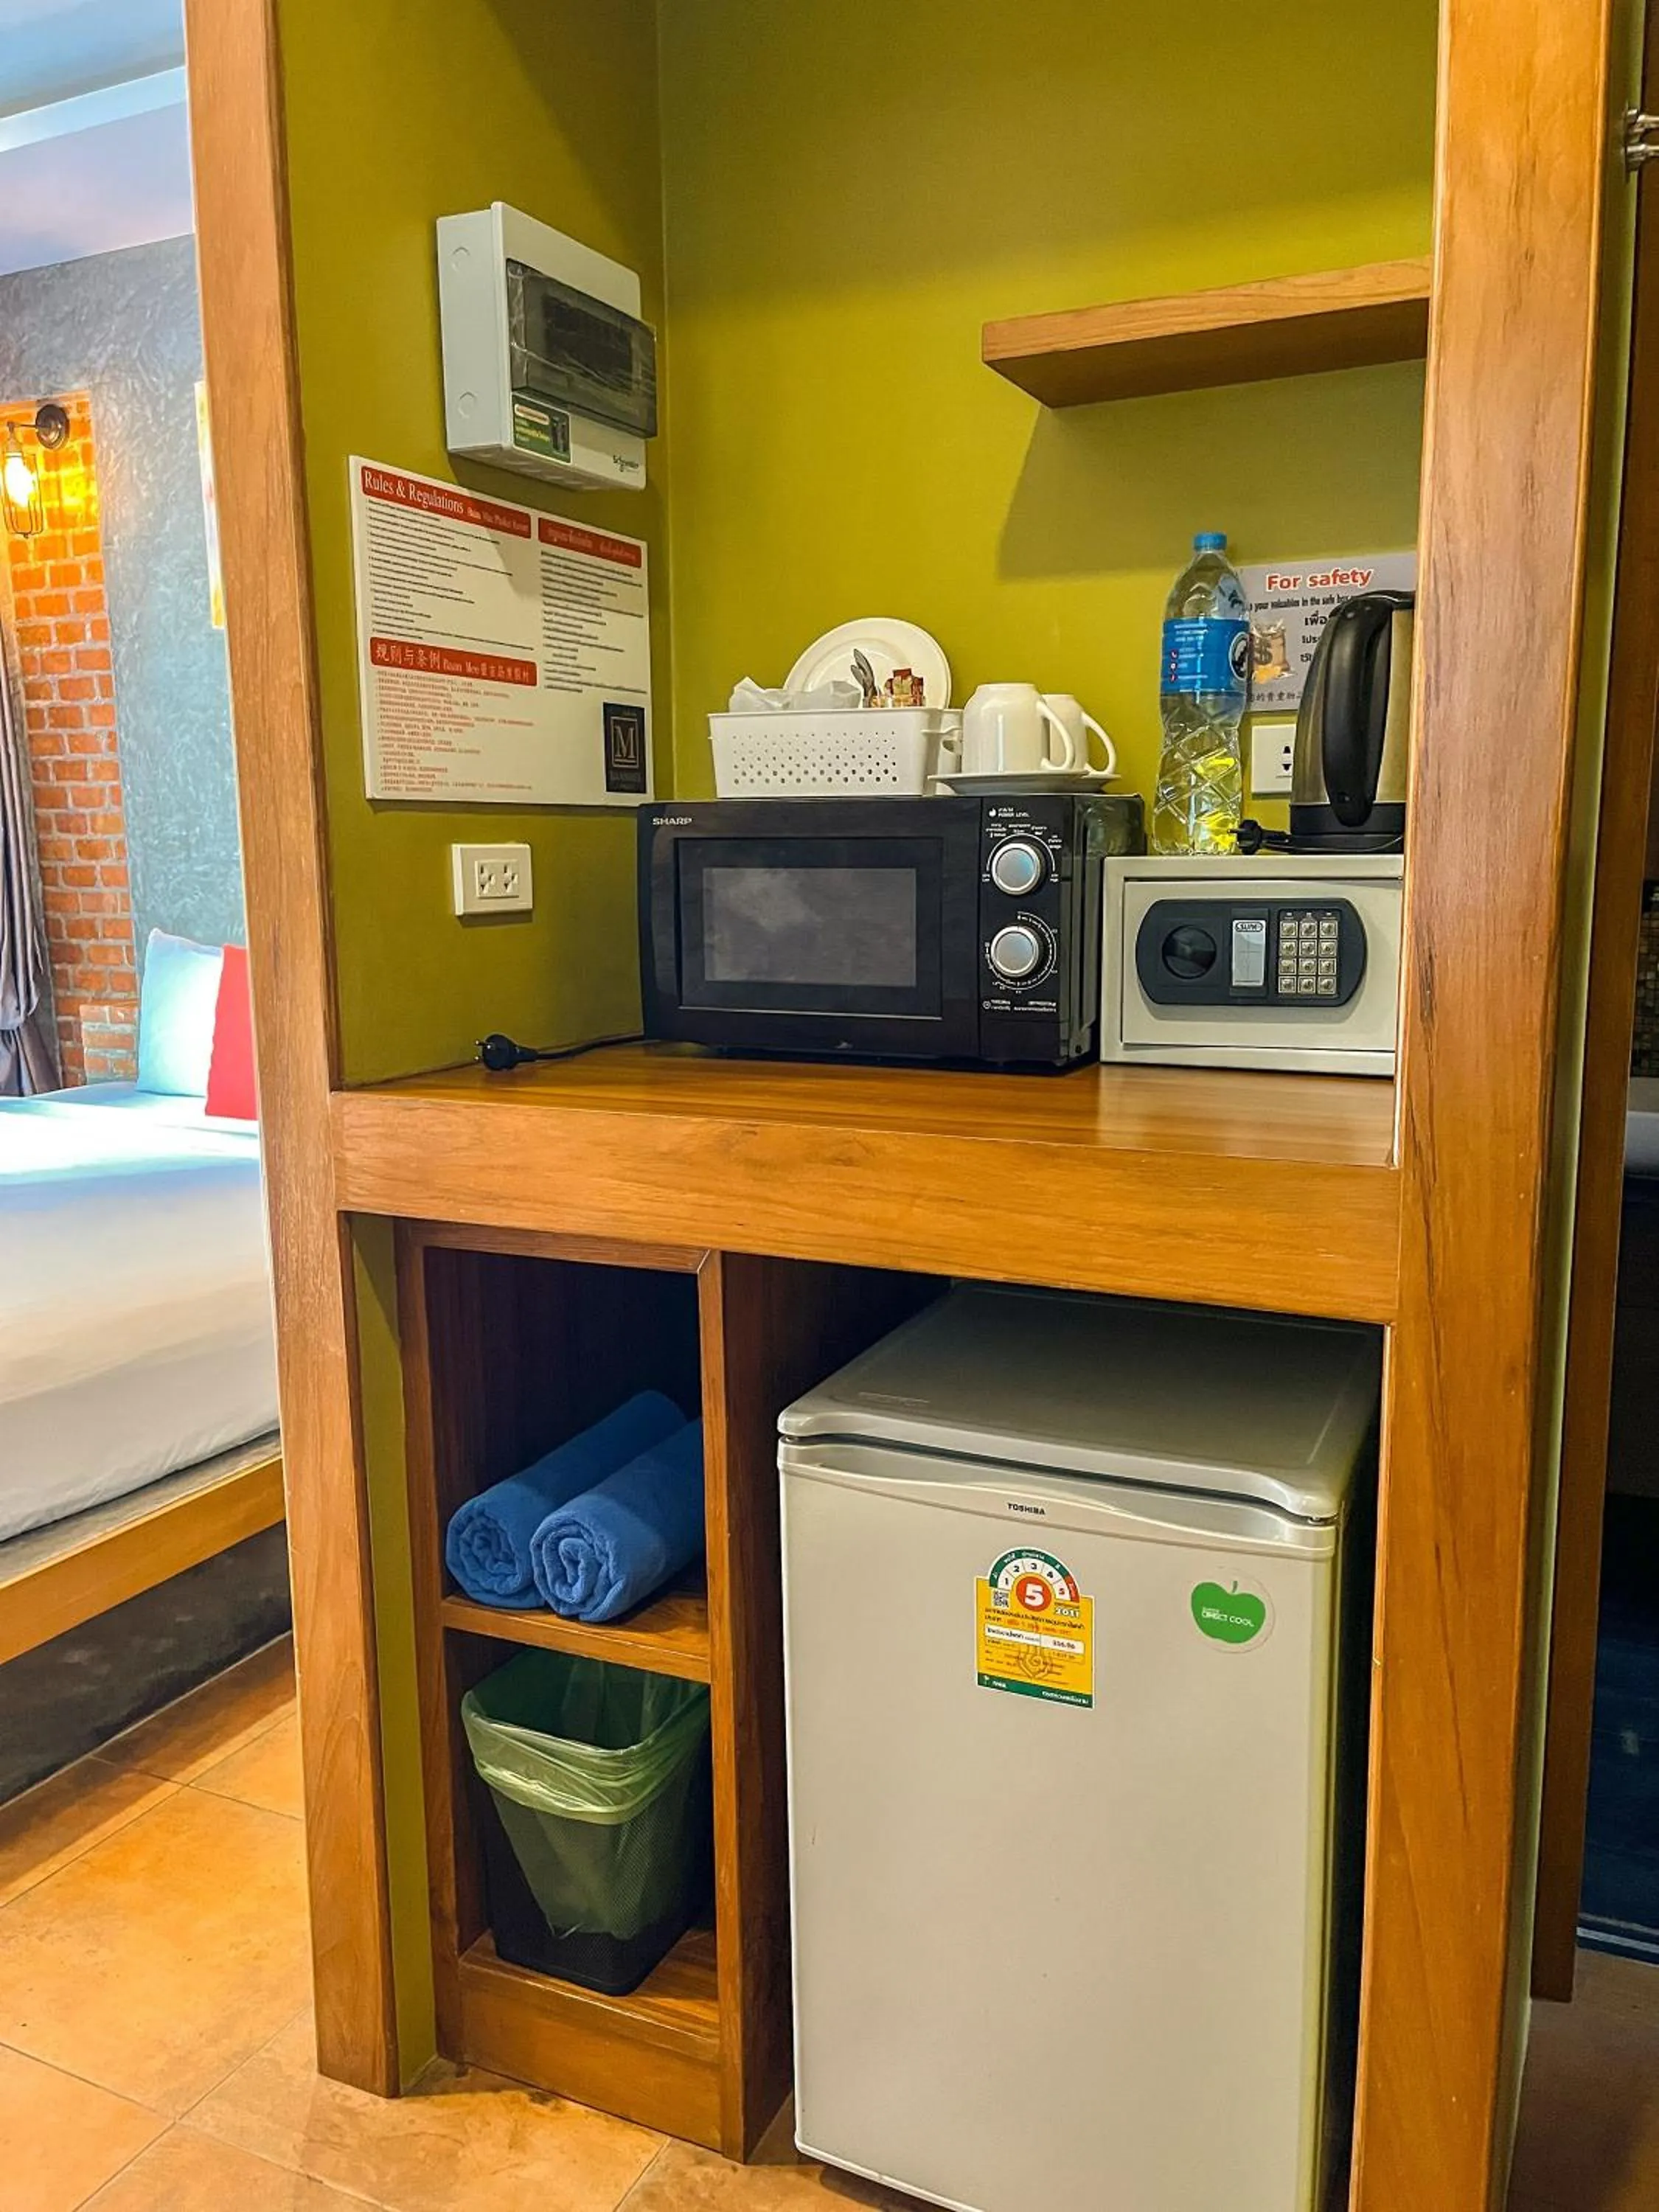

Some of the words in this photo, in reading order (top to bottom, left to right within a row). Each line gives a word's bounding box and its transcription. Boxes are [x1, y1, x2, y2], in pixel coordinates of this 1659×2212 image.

[364, 470, 394, 495] Rules
[396, 481, 406, 498] &
[408, 483, 464, 513] Regulations
[1267, 574, 1301, 591] For
[1308, 568, 1373, 588] safety
[613, 725, 636, 759] M
[1007, 1502, 1046, 1515] TOSHIBA
[1004, 1577, 1009, 1586] 1
[1024, 1582, 1045, 1607] 5
[1058, 1587, 1065, 1596] 5
[1229, 1615, 1255, 1627] COOL
